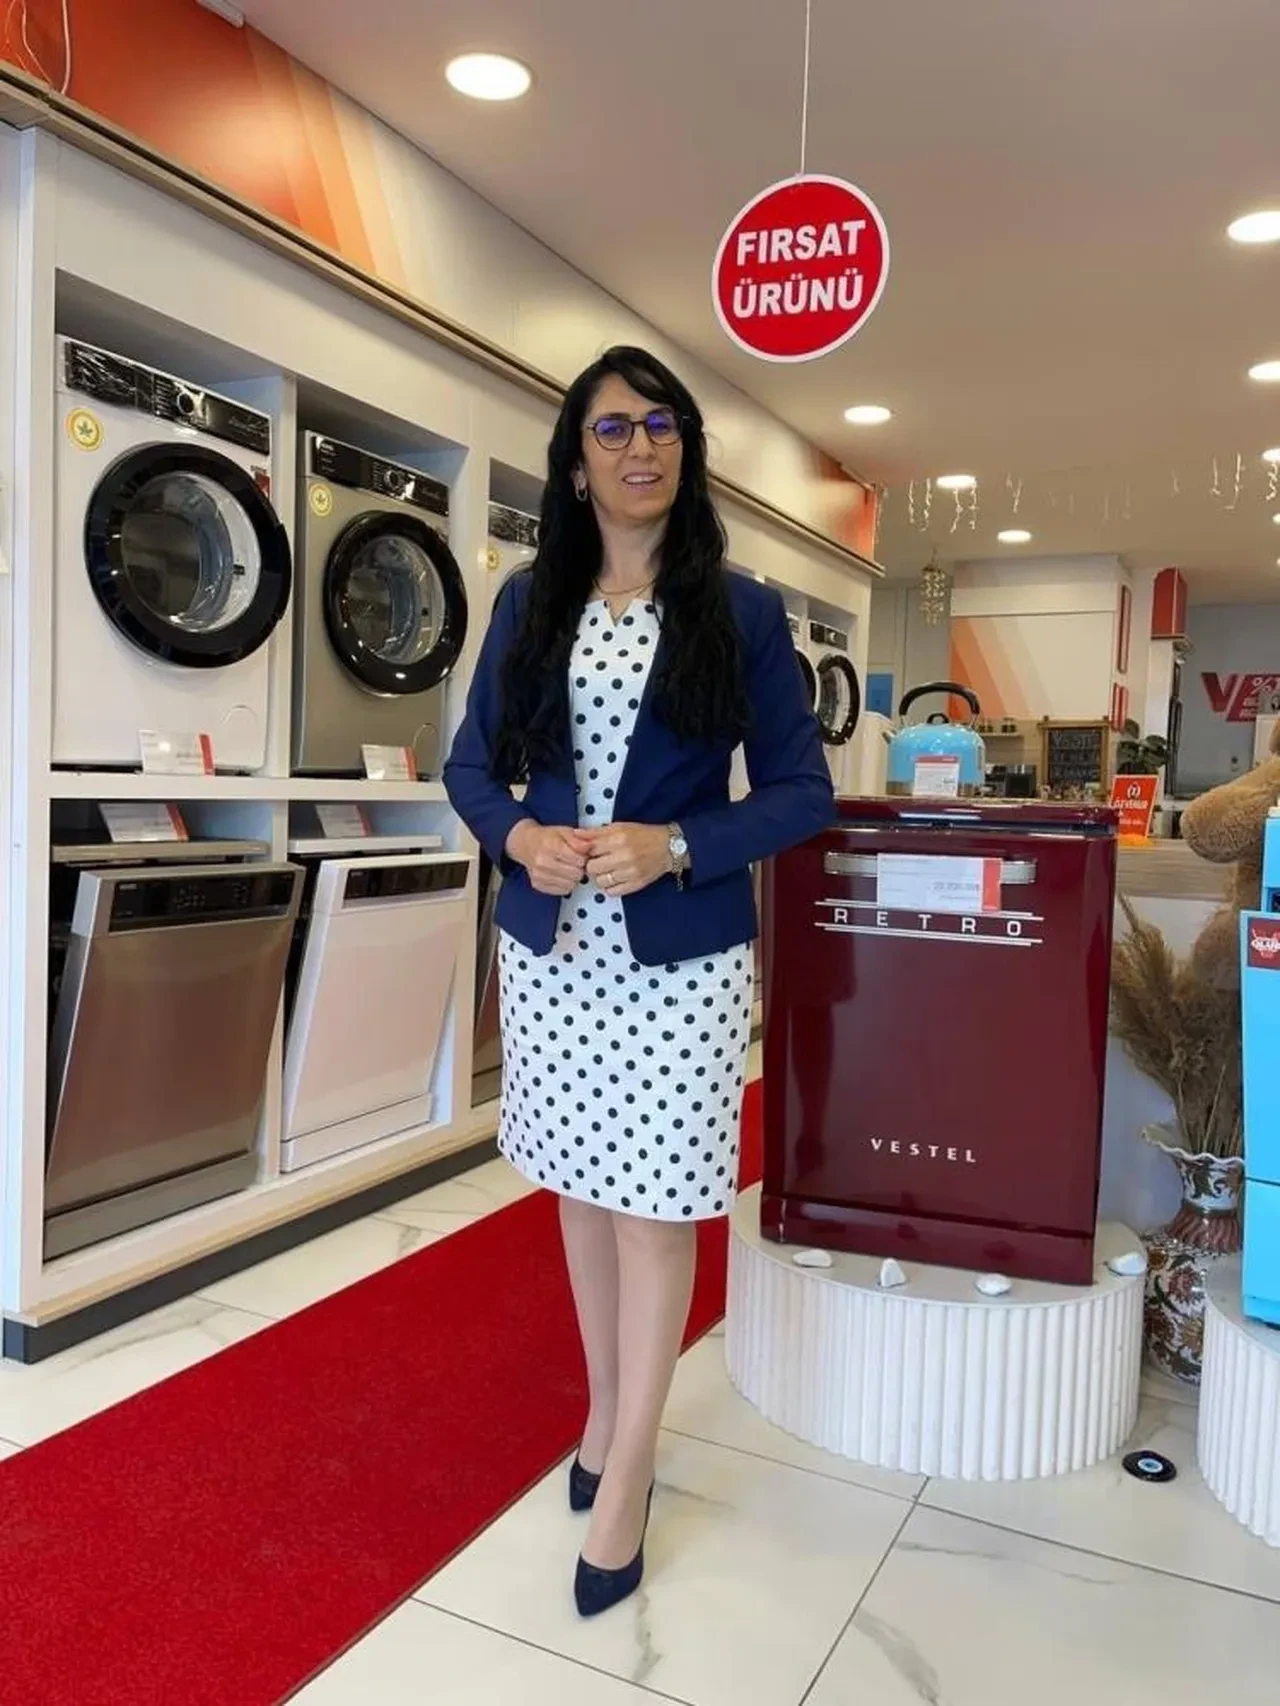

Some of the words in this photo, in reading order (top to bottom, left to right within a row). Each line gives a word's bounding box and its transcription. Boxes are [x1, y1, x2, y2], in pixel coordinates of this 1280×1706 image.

[736, 219, 866, 267] FIRSAT
[732, 267, 864, 319] ÜRÜNÜ
[833, 907, 1022, 937] RETRO
[870, 1137, 976, 1163] VESTEL
